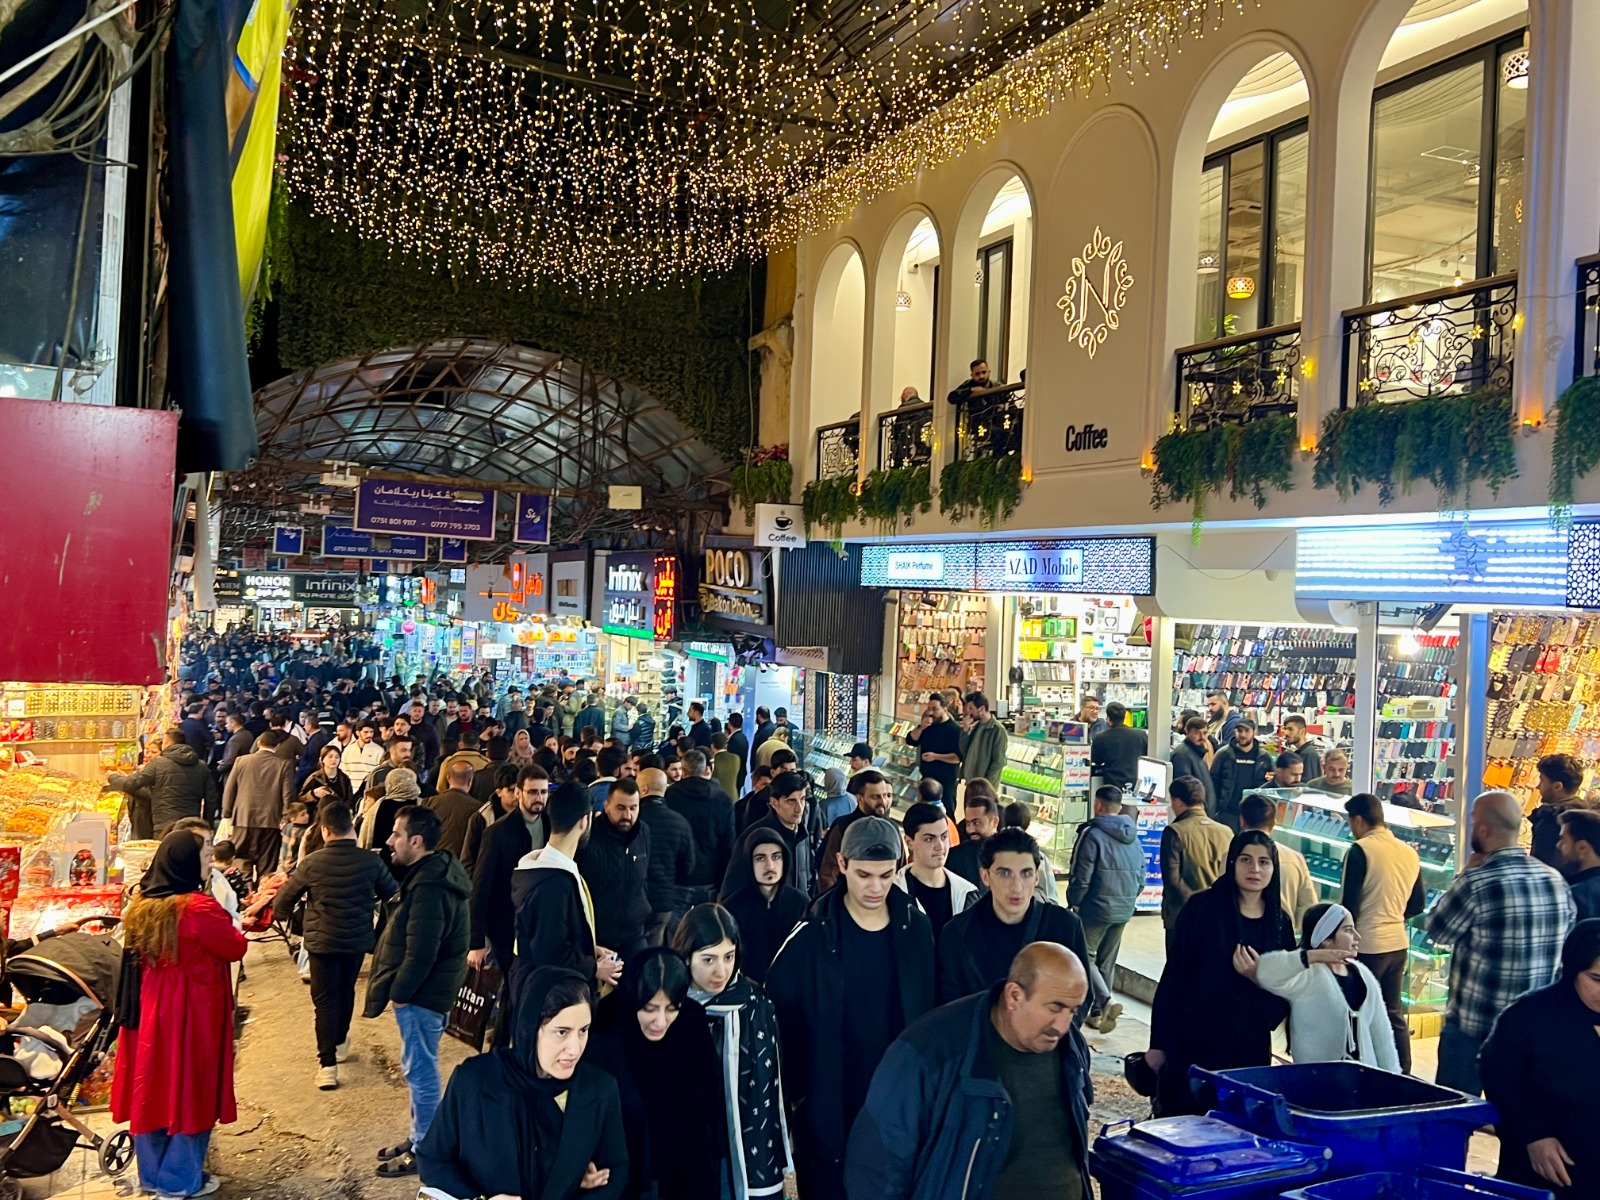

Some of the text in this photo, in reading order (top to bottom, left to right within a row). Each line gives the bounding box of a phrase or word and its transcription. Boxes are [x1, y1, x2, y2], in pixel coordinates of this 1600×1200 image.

[1065, 423, 1108, 452] Coffee
[370, 516, 388, 524] 0751
[388, 517, 402, 525] 801
[402, 518, 417, 526] 9117
[430, 520, 448, 529] 0777
[463, 523, 481, 531] 3703
[768, 533, 797, 543] Coffee
[705, 548, 746, 588] POCO
[895, 560, 934, 570] SHAIK Perfume
[1007, 556, 1079, 576] AZAD Mobile
[245, 575, 291, 587] HONOR
[608, 563, 644, 591] Infinix
[305, 578, 357, 592] Infinix
[453, 999, 479, 1015] XURY
